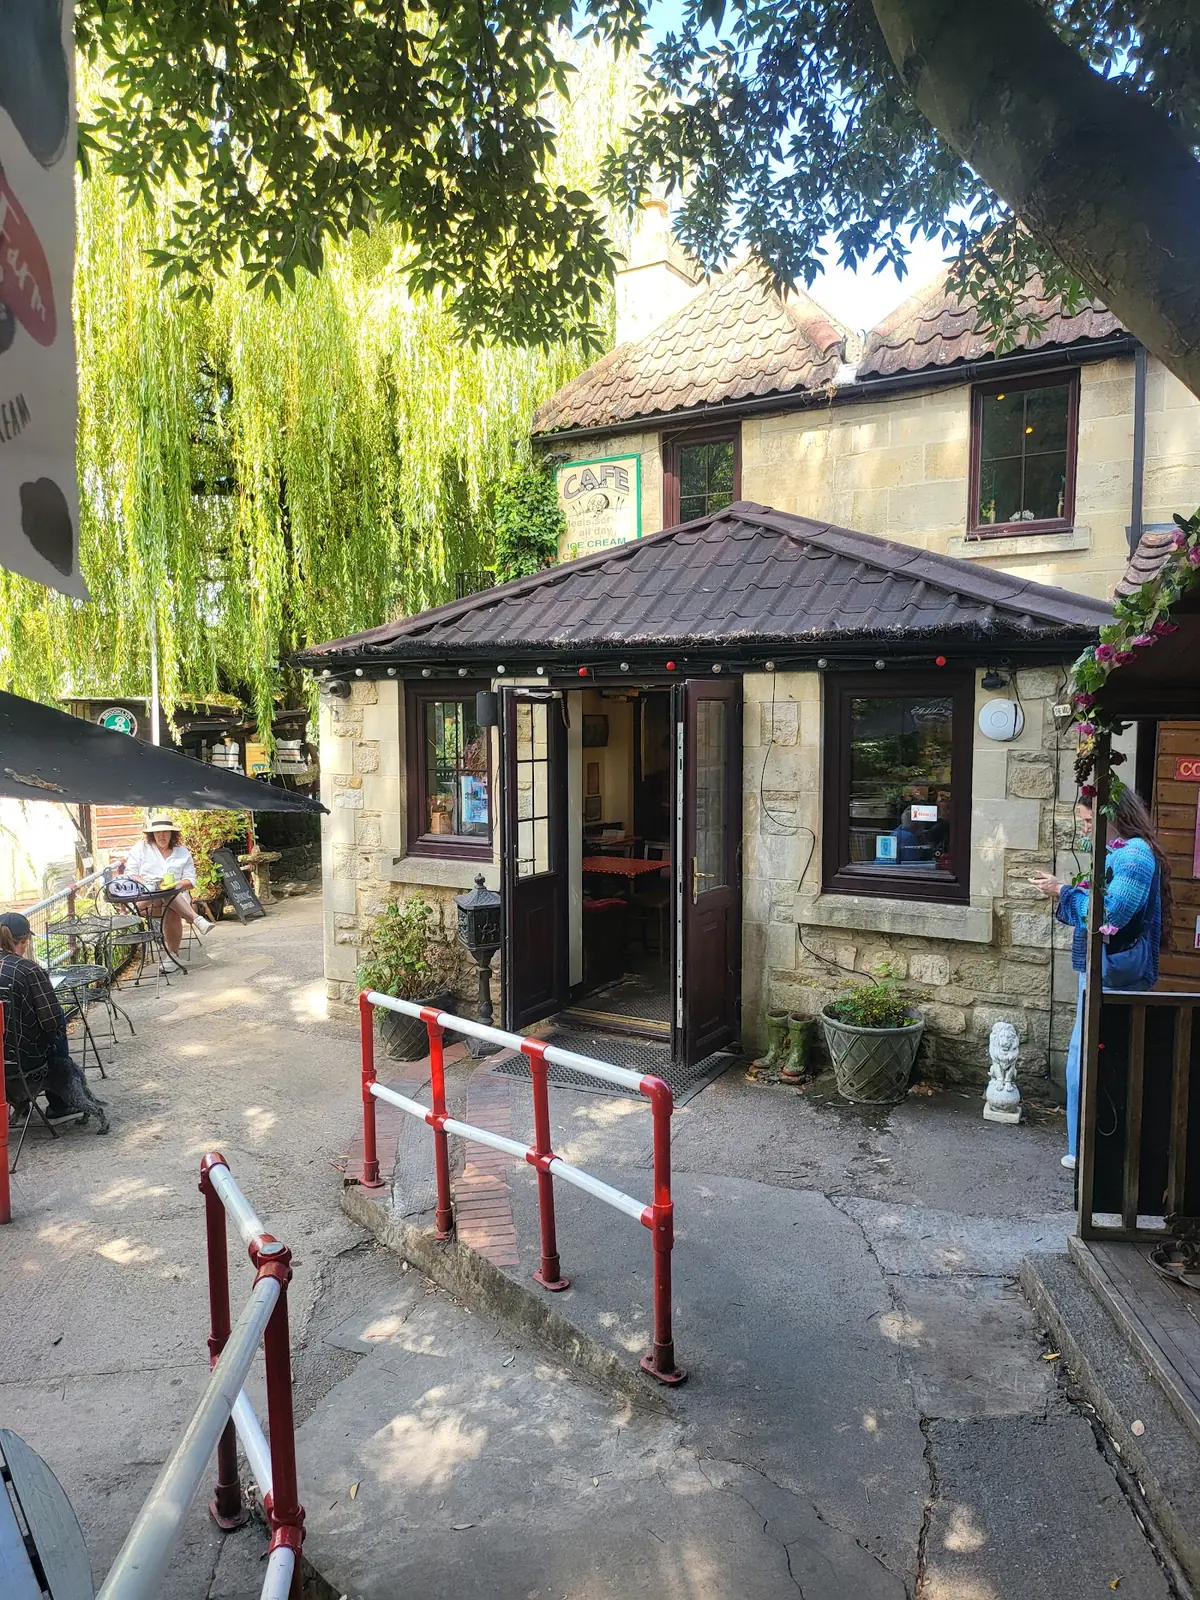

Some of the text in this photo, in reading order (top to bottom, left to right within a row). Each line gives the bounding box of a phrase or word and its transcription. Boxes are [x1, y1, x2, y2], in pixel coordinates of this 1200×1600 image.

[563, 464, 630, 500] CAFE
[567, 537, 627, 550] ICE CREAM
[102, 709, 132, 720] BROOKLYN
